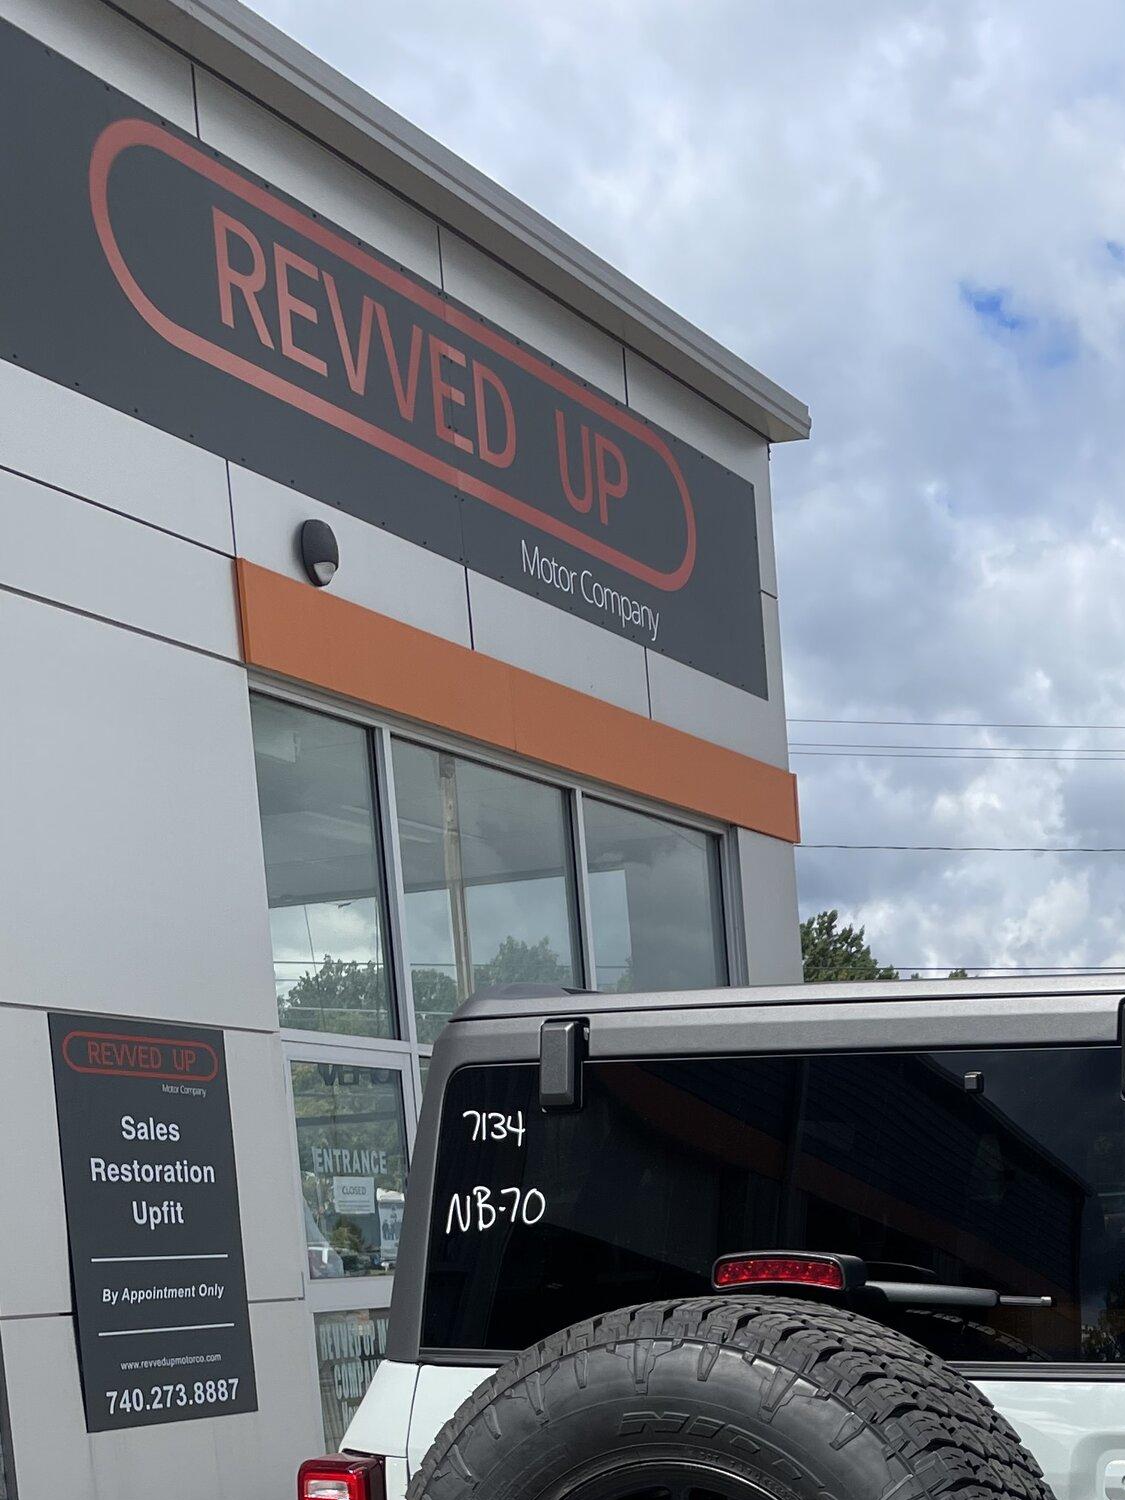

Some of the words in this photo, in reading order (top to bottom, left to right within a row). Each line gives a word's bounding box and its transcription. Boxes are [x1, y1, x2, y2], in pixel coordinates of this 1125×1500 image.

[212, 206, 516, 469] REVVED
[555, 408, 629, 526] UP
[520, 539, 577, 594] Motor
[580, 570, 660, 641] Company
[87, 1039, 162, 1069] REVVED
[173, 1049, 197, 1072] UP
[162, 1083, 180, 1094] Motor
[180, 1085, 207, 1098] Company
[121, 1115, 181, 1142] Sales
[462, 1110, 526, 1147] 7134
[90, 1157, 216, 1183] Restoration
[314, 1148, 387, 1175] ENTRANCE
[341, 1185, 367, 1196] CLOSED
[132, 1200, 185, 1230] Upfit
[446, 1186, 546, 1234] NB-70
[102, 1288, 119, 1305] By
[121, 1285, 196, 1304] Appointment
[199, 1283, 225, 1299] Only
[106, 1378, 239, 1415] 740.273.8887
